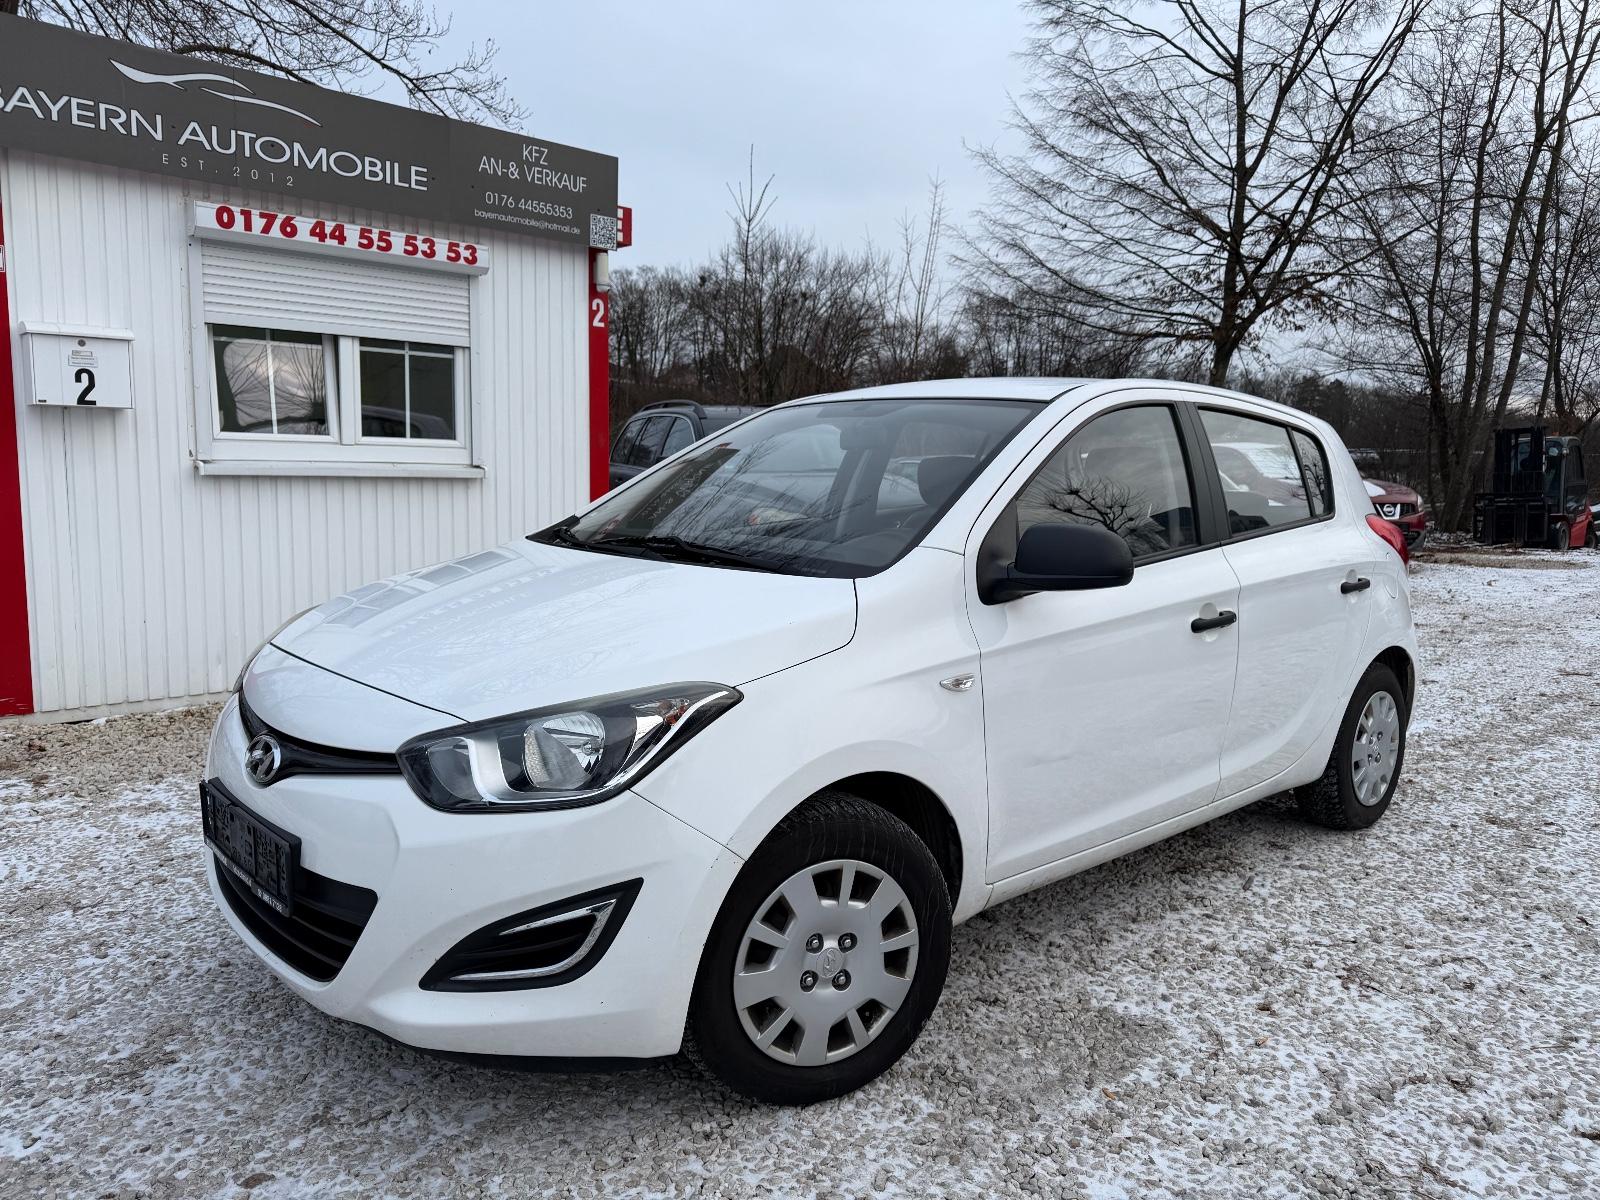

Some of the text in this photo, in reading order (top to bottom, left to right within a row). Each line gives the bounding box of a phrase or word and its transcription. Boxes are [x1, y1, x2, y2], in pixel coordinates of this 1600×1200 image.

[0, 86, 428, 191] AYERN AUTOMOBILE
[522, 143, 549, 166] KFZ
[233, 166, 293, 186] 2012
[524, 164, 588, 193] VERKAUF
[485, 191, 573, 220] 0176 44555353
[215, 205, 478, 266] 0176 44 55 53 53
[474, 208, 581, 235] bayernautomobile@hotmail.de
[592, 298, 605, 328] 2
[74, 367, 97, 406] 2
